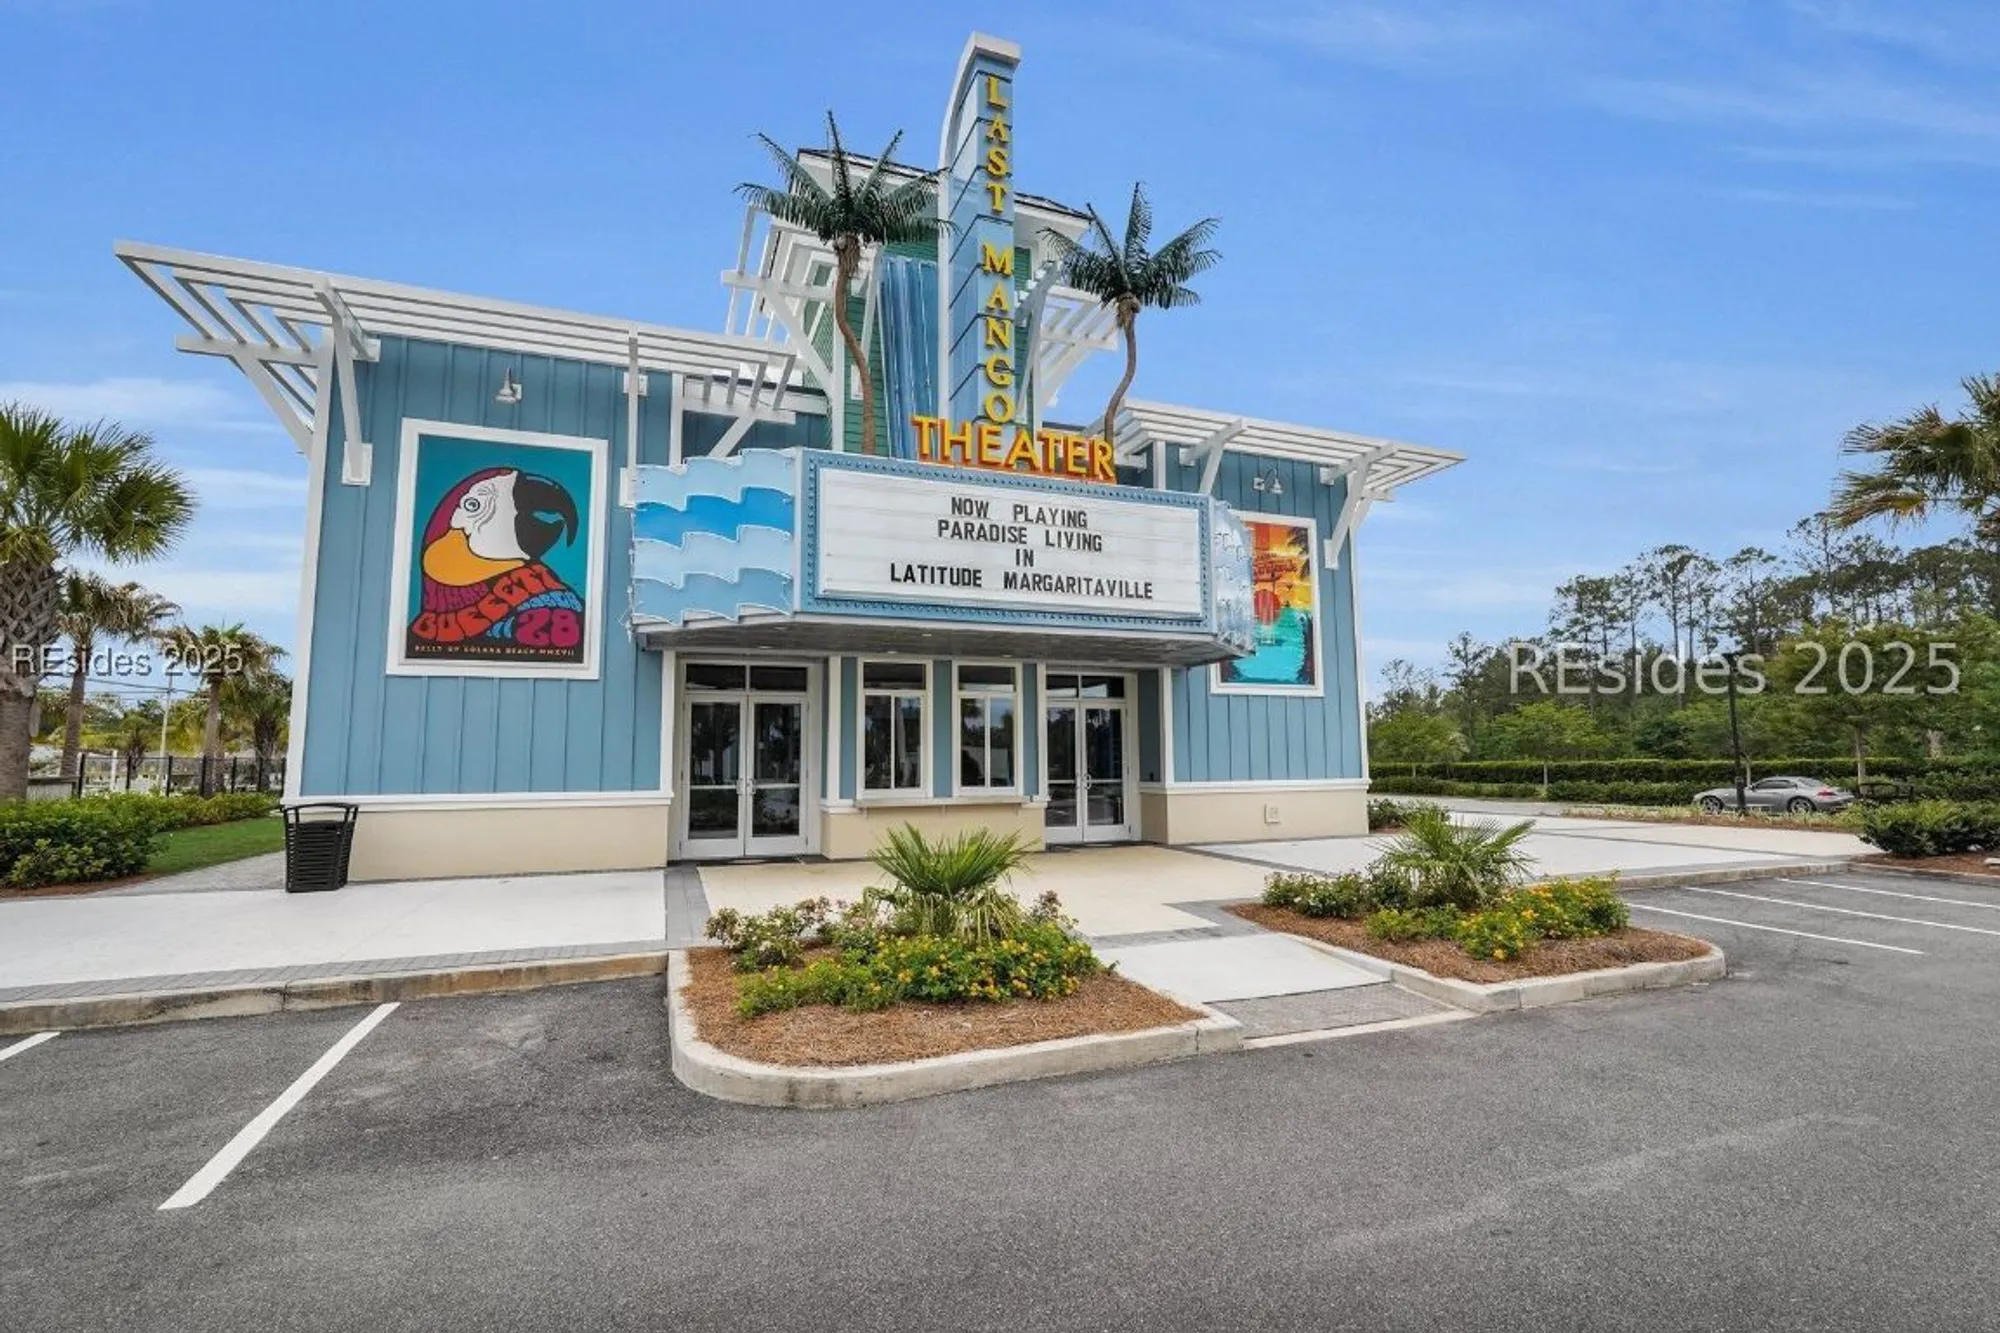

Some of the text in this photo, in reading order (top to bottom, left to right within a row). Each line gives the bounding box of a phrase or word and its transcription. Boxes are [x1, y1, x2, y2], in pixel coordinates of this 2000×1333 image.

[981, 76, 1016, 424] LAST MANGO
[911, 414, 1117, 485] THEATER
[951, 496, 1088, 529] NOW PLAYING
[937, 519, 1103, 552] PARADISE LIVING
[1015, 548, 1035, 568] IN
[890, 562, 1153, 600] LATITUDE MARGARITAVILLE
[515, 606, 580, 647] 28
